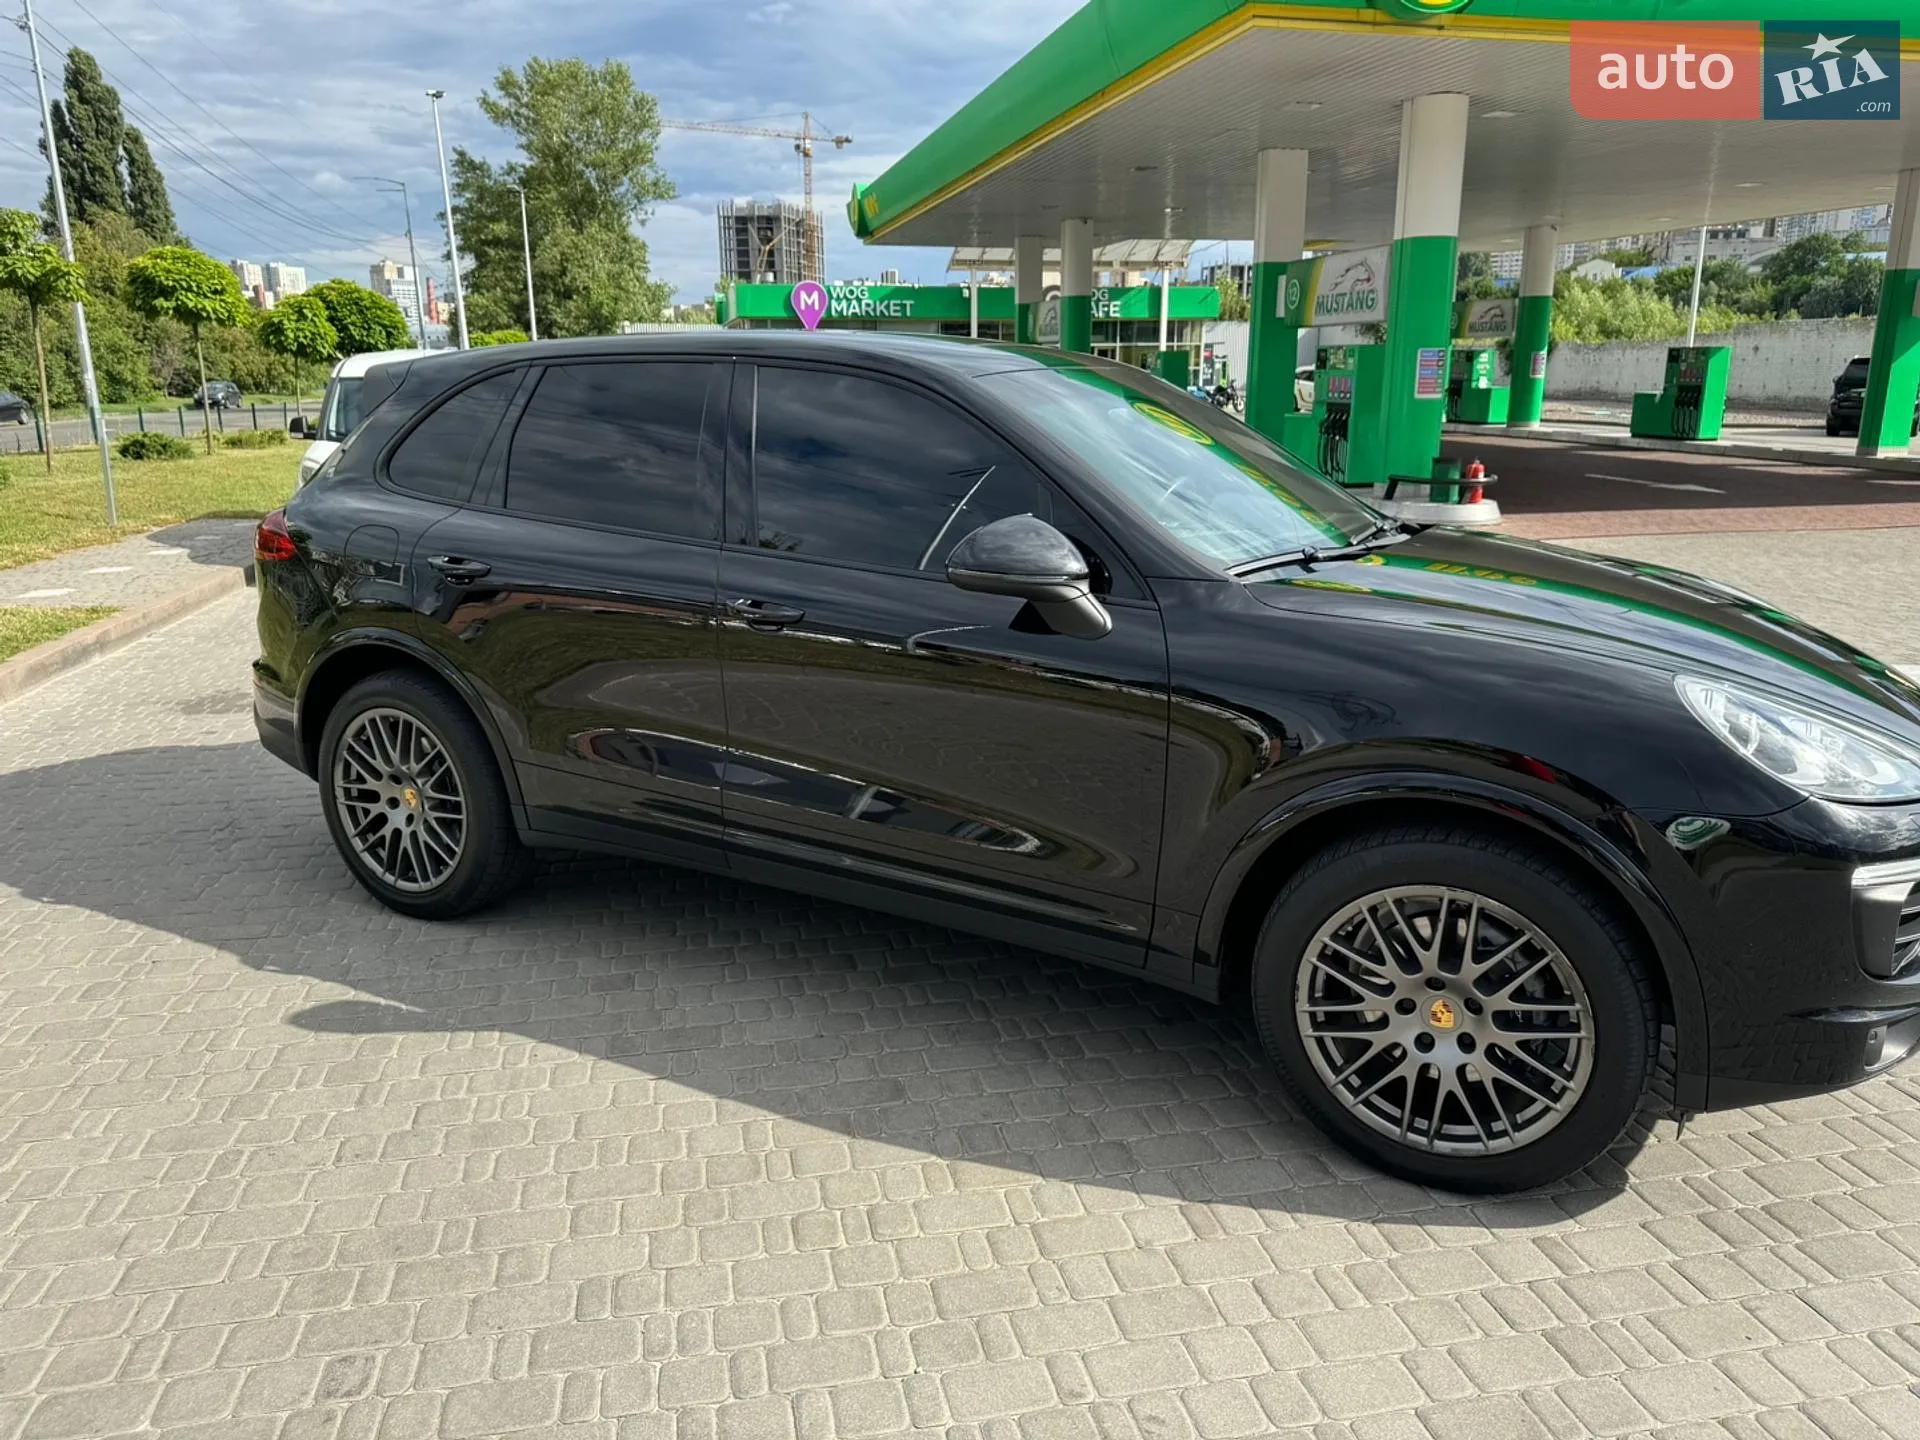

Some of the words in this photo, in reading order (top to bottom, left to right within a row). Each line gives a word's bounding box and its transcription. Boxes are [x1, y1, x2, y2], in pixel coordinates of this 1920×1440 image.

[800, 290, 819, 310] M
[829, 286, 868, 299] WOG
[831, 300, 915, 316] MARKET
[1316, 288, 1377, 316] MUSTANG
